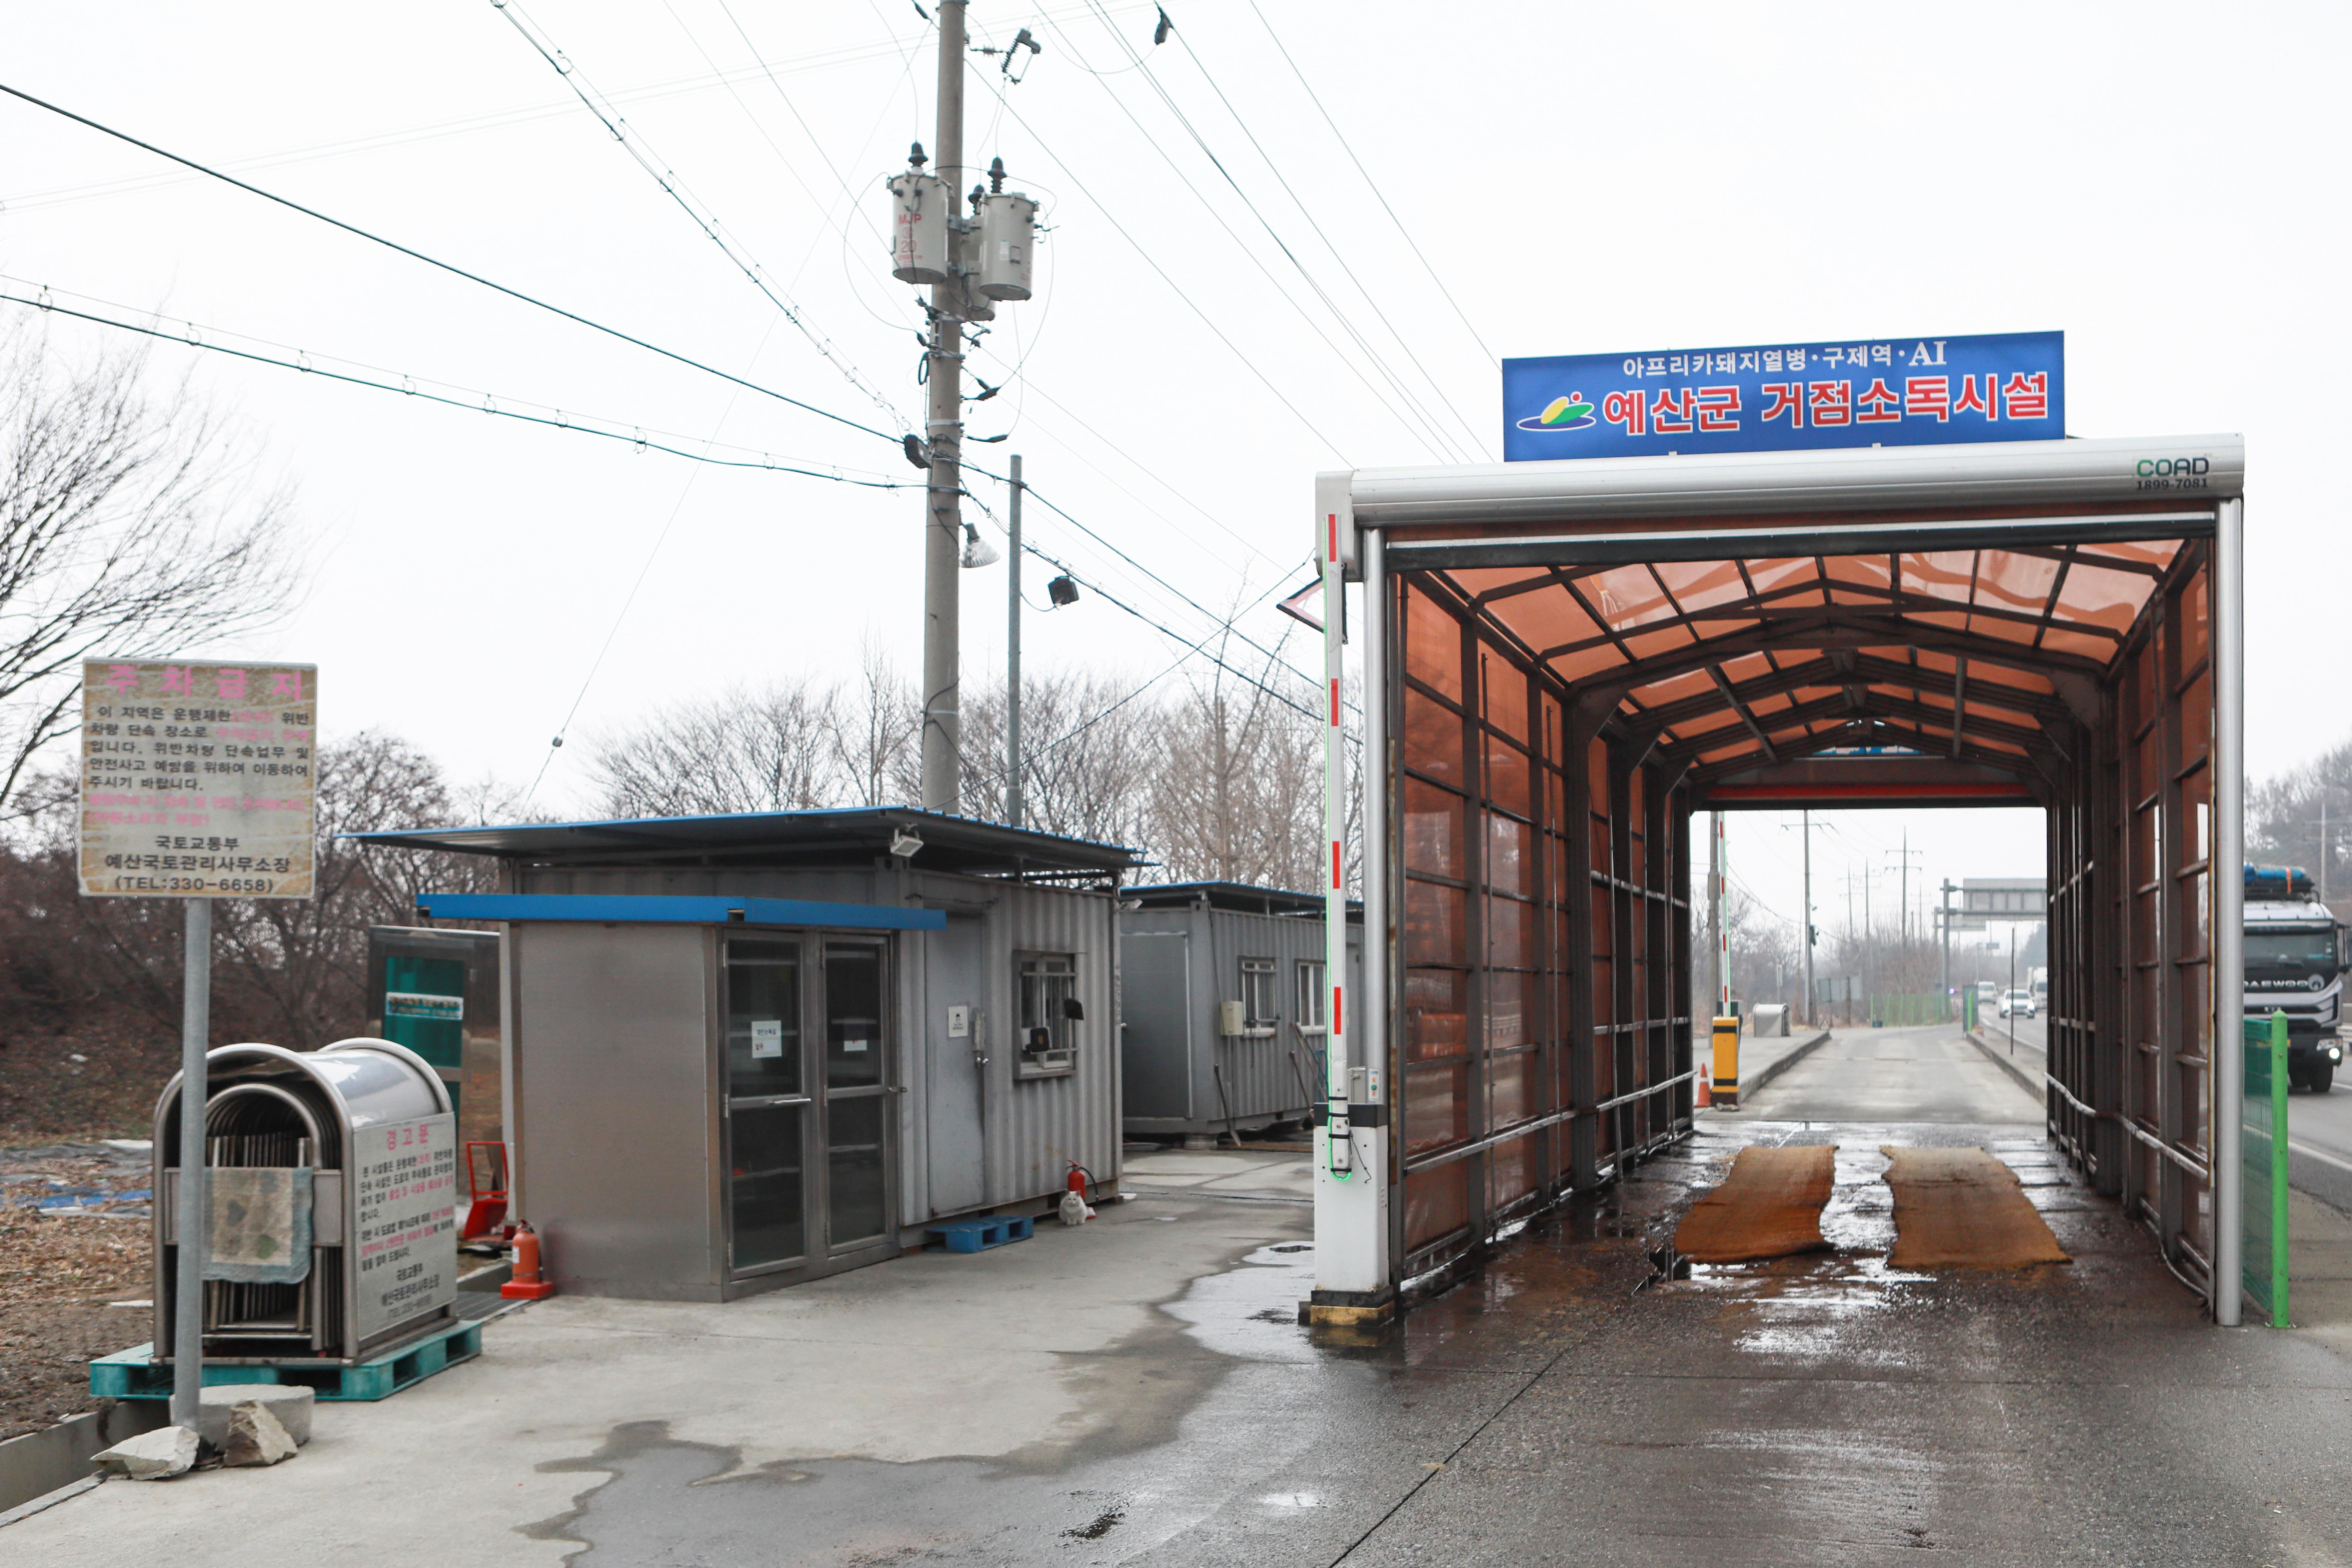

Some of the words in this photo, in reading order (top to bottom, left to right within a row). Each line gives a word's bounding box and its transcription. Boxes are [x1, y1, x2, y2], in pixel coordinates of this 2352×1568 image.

[1602, 385, 1742, 436] 예산군
[1761, 371, 2048, 429] 거점소독시설
[2137, 457, 2209, 476] COAD
[2136, 478, 2208, 490] 1899-7081
[98, 706, 111, 717] 이
[122, 706, 164, 720] 지역은
[281, 712, 309, 725] 위반
[91, 722, 119, 736] 차량
[128, 723, 156, 736] 단속
[166, 726, 207, 737] 장소로
[91, 741, 143, 755] 입니다.
[225, 744, 285, 759] 단속업무
[296, 747, 308, 759] 및
[89, 758, 146, 771] 안전사고
[153, 760, 197, 773] 예방을
[204, 761, 245, 774] 위하여
[253, 763, 308, 777] 이동하여
[89, 775, 132, 789] 주시기
[141, 777, 203, 790] 바랍니다.
[155, 835, 240, 851] 국토교통부
[105, 853, 291, 873] 예산국토관리사무소장
[115, 875, 273, 893] (TEL:330-6658)
